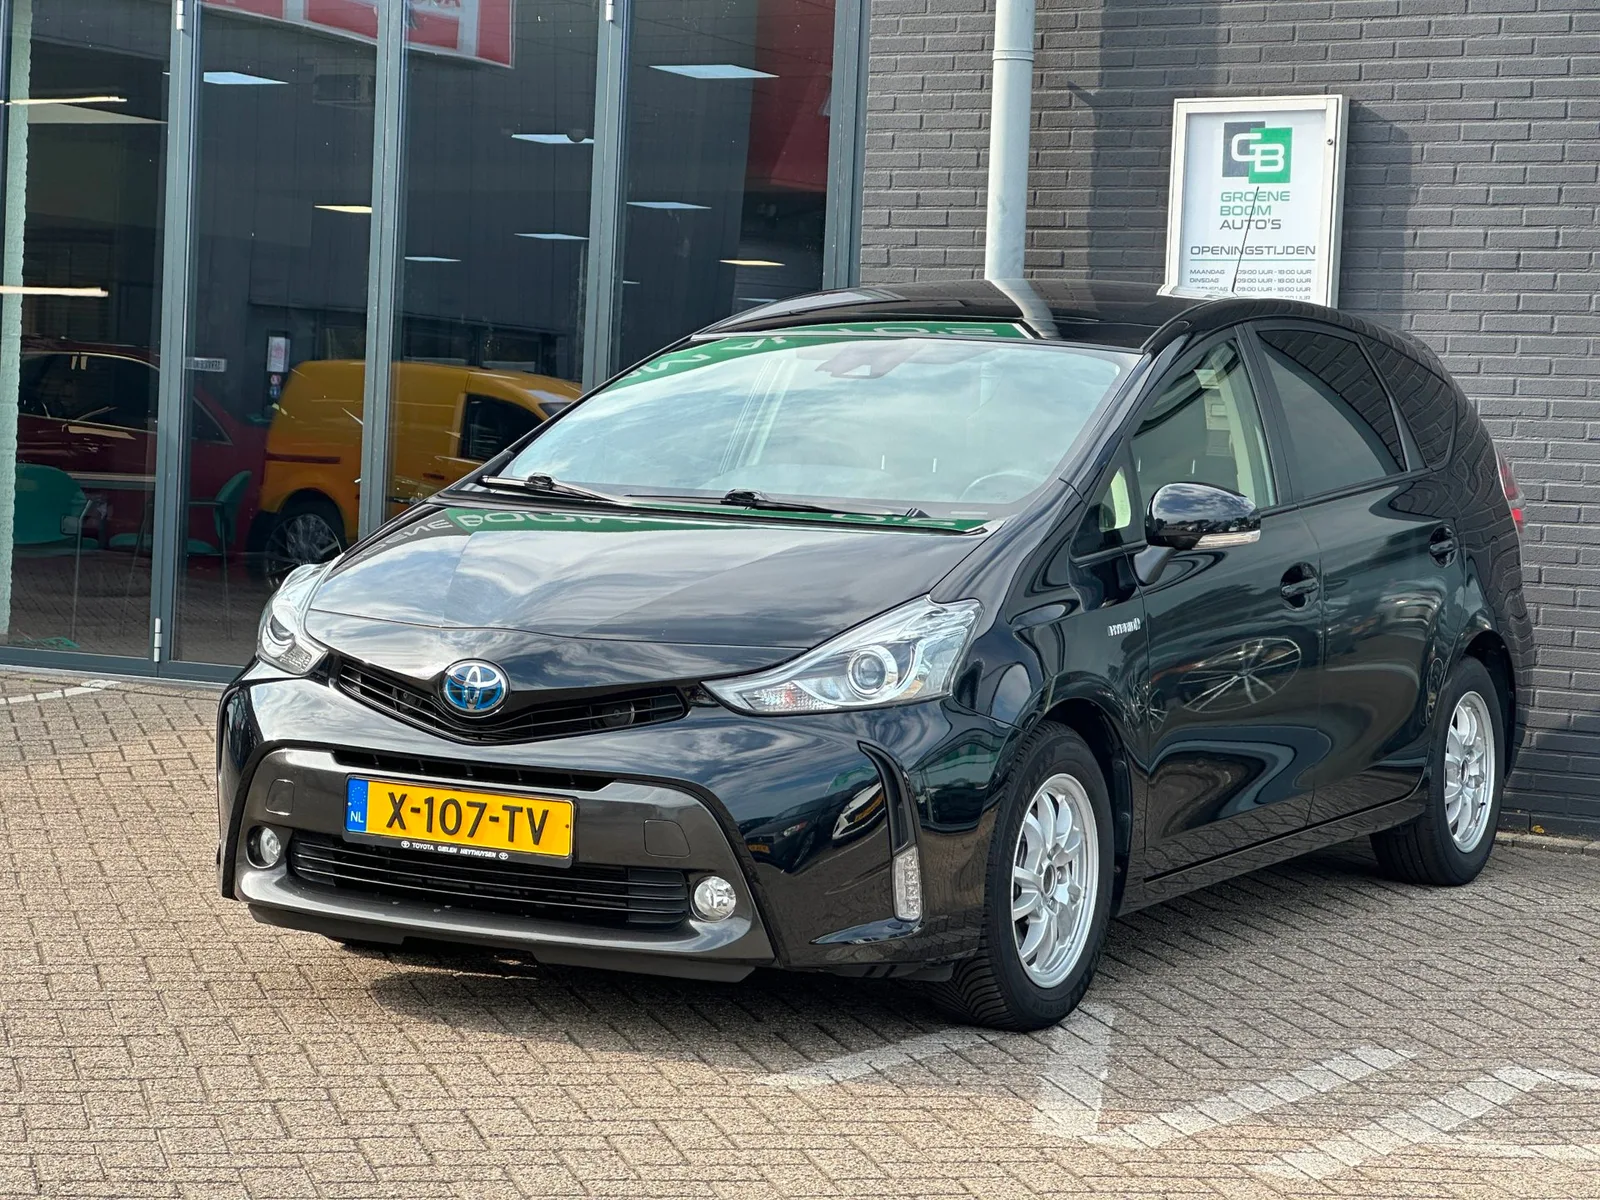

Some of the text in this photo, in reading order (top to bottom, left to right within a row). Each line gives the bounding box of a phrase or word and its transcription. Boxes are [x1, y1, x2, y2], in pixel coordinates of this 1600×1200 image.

[1221, 190, 1291, 202] GROENE
[1219, 204, 1272, 216] BOOM
[1219, 218, 1282, 230] AUTO'S
[1190, 245, 1316, 256] OPENINGSTIJDEN
[350, 791, 549, 846] NL X-107-TV
[411, 842, 435, 851] TOYOTA
